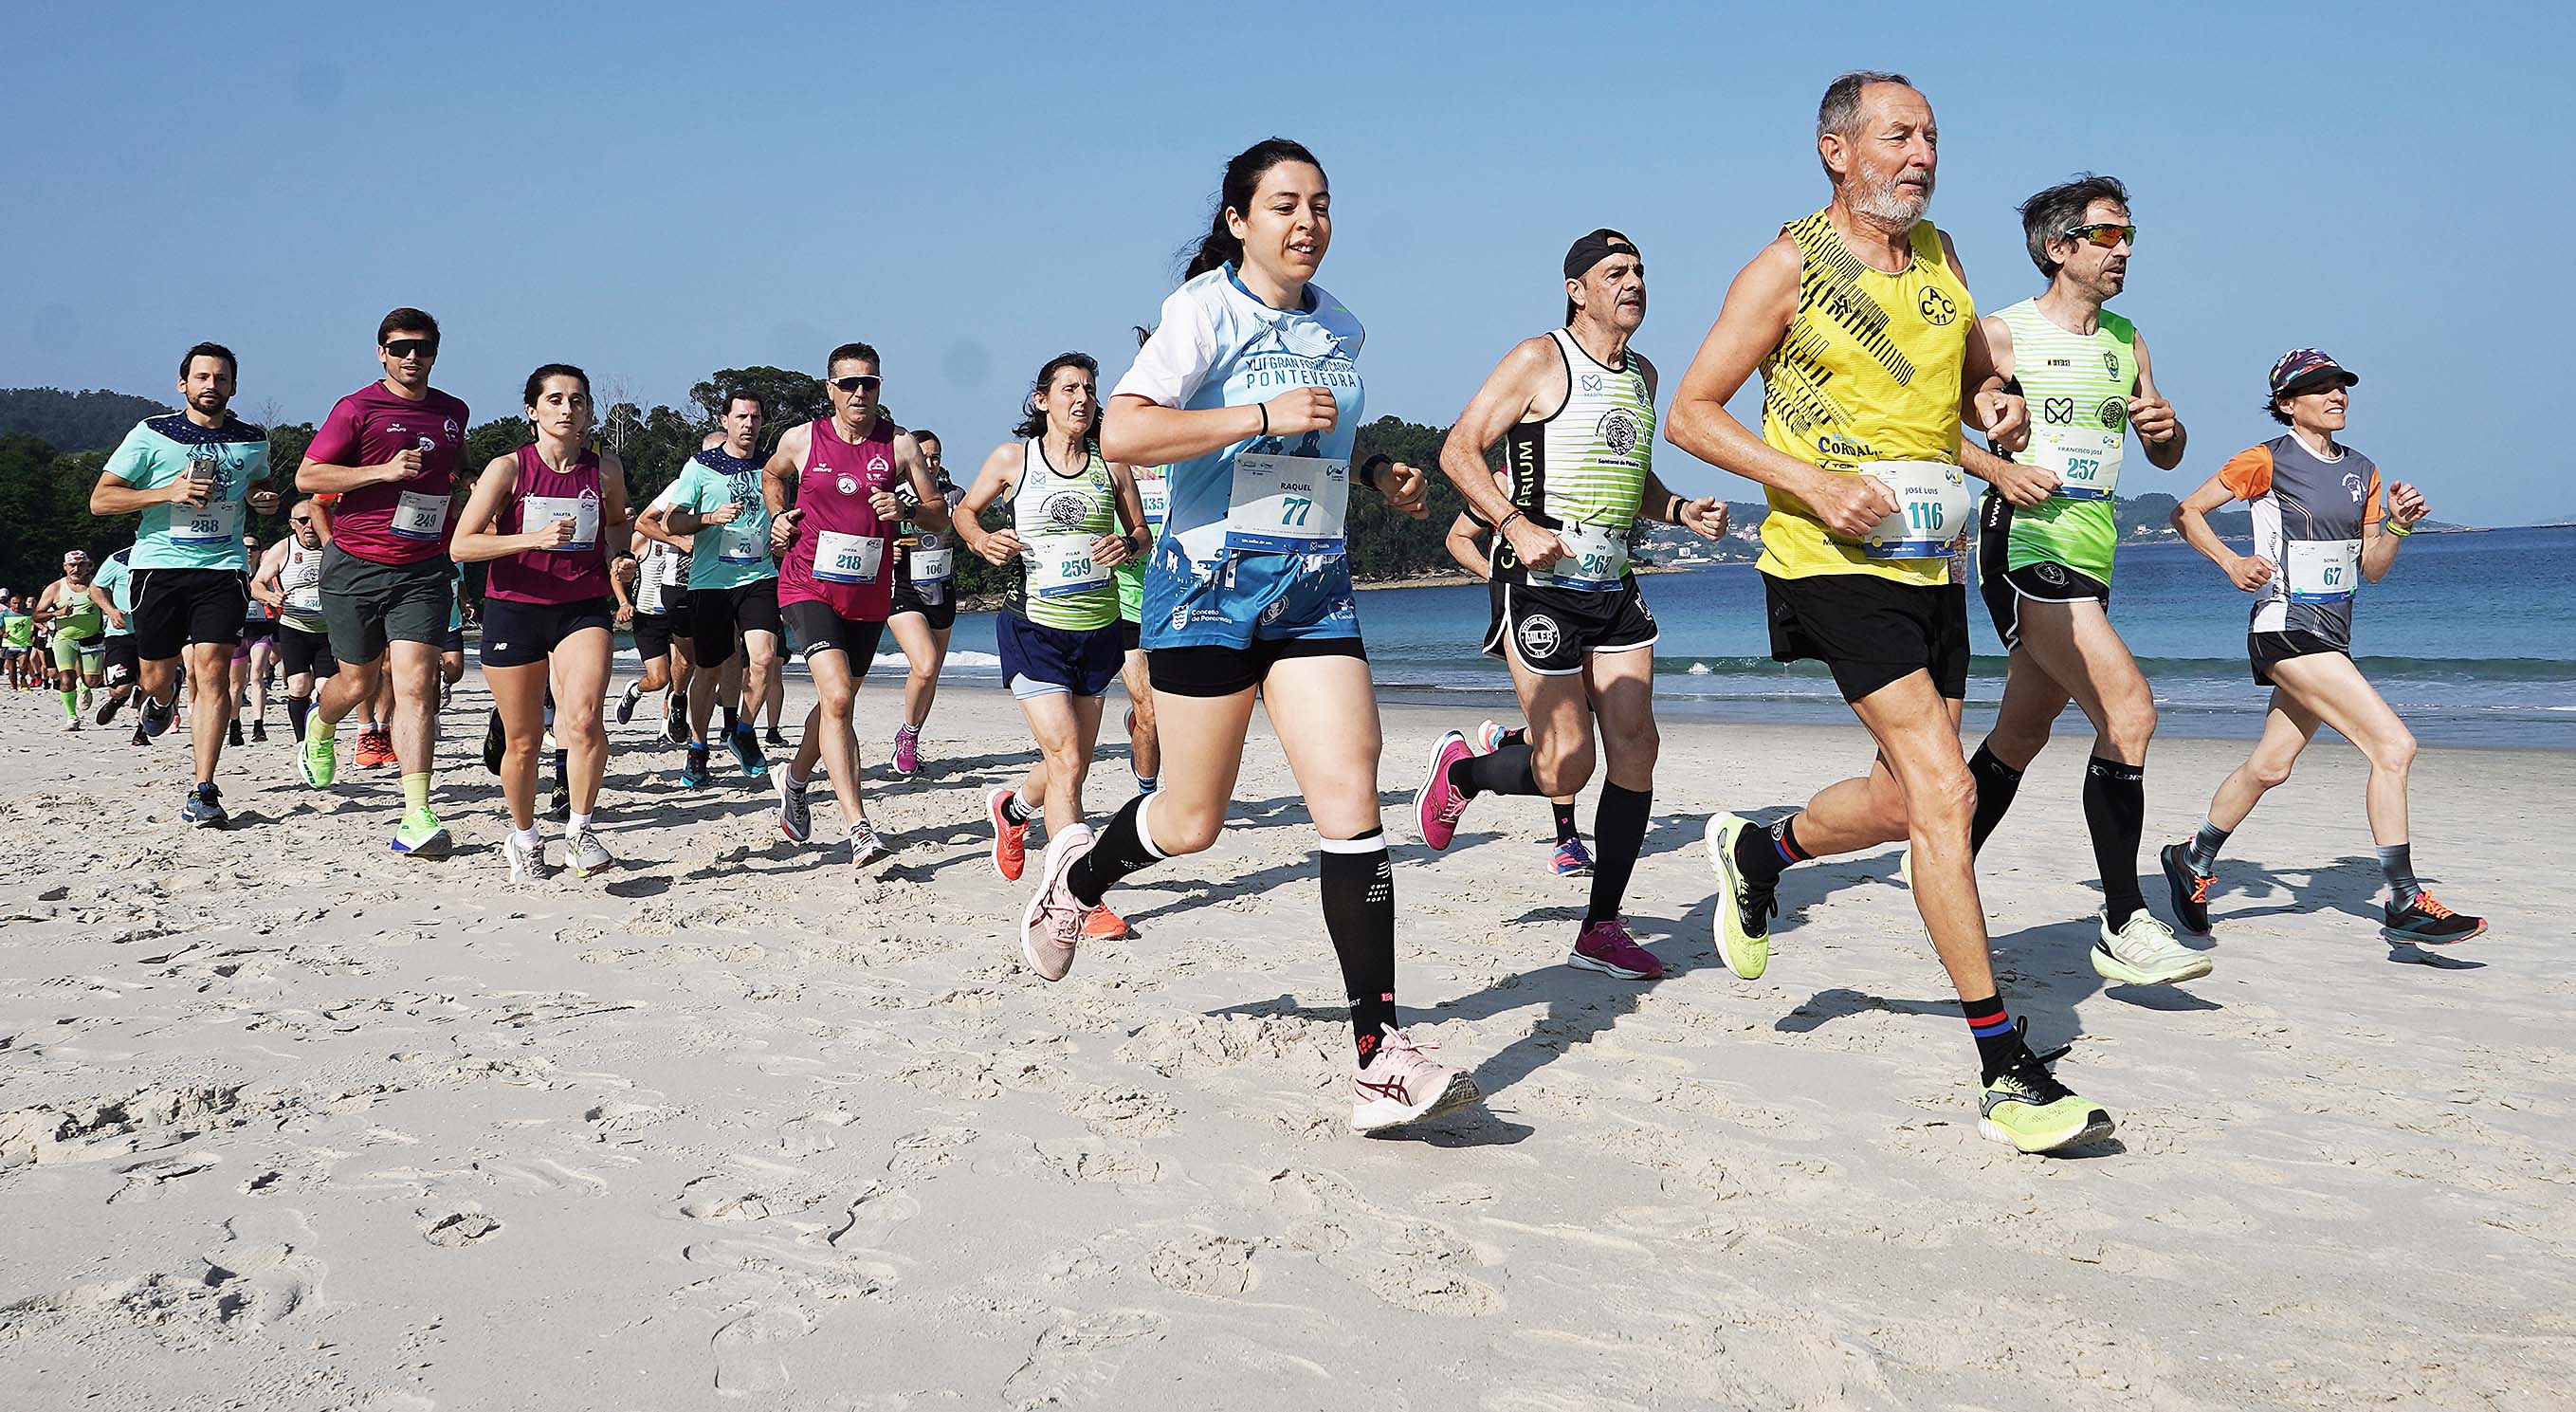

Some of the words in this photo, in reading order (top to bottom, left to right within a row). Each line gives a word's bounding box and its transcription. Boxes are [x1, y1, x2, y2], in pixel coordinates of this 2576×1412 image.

[1270, 358, 1299, 369] GRAN
[1300, 358, 1328, 373] FONDO
[1247, 370, 1357, 389] PONTEVEDRA
[2067, 457, 2099, 481] 257
[1281, 483, 1312, 491] RAQUEL
[1905, 486, 1923, 495] JOSÉ
[1142, 498, 1164, 510] 135
[1281, 497, 1313, 526] 77
[413, 513, 436, 527] 249
[1909, 502, 1944, 531] 116
[191, 520, 219, 532] 288
[740, 542, 751, 554] 73
[836, 554, 862, 570] 218
[925, 563, 942, 575] 106
[1062, 558, 1091, 578] 259
[1582, 554, 1613, 574] 262
[2323, 567, 2343, 586] 67
[1526, 630, 1553, 643] MILER
